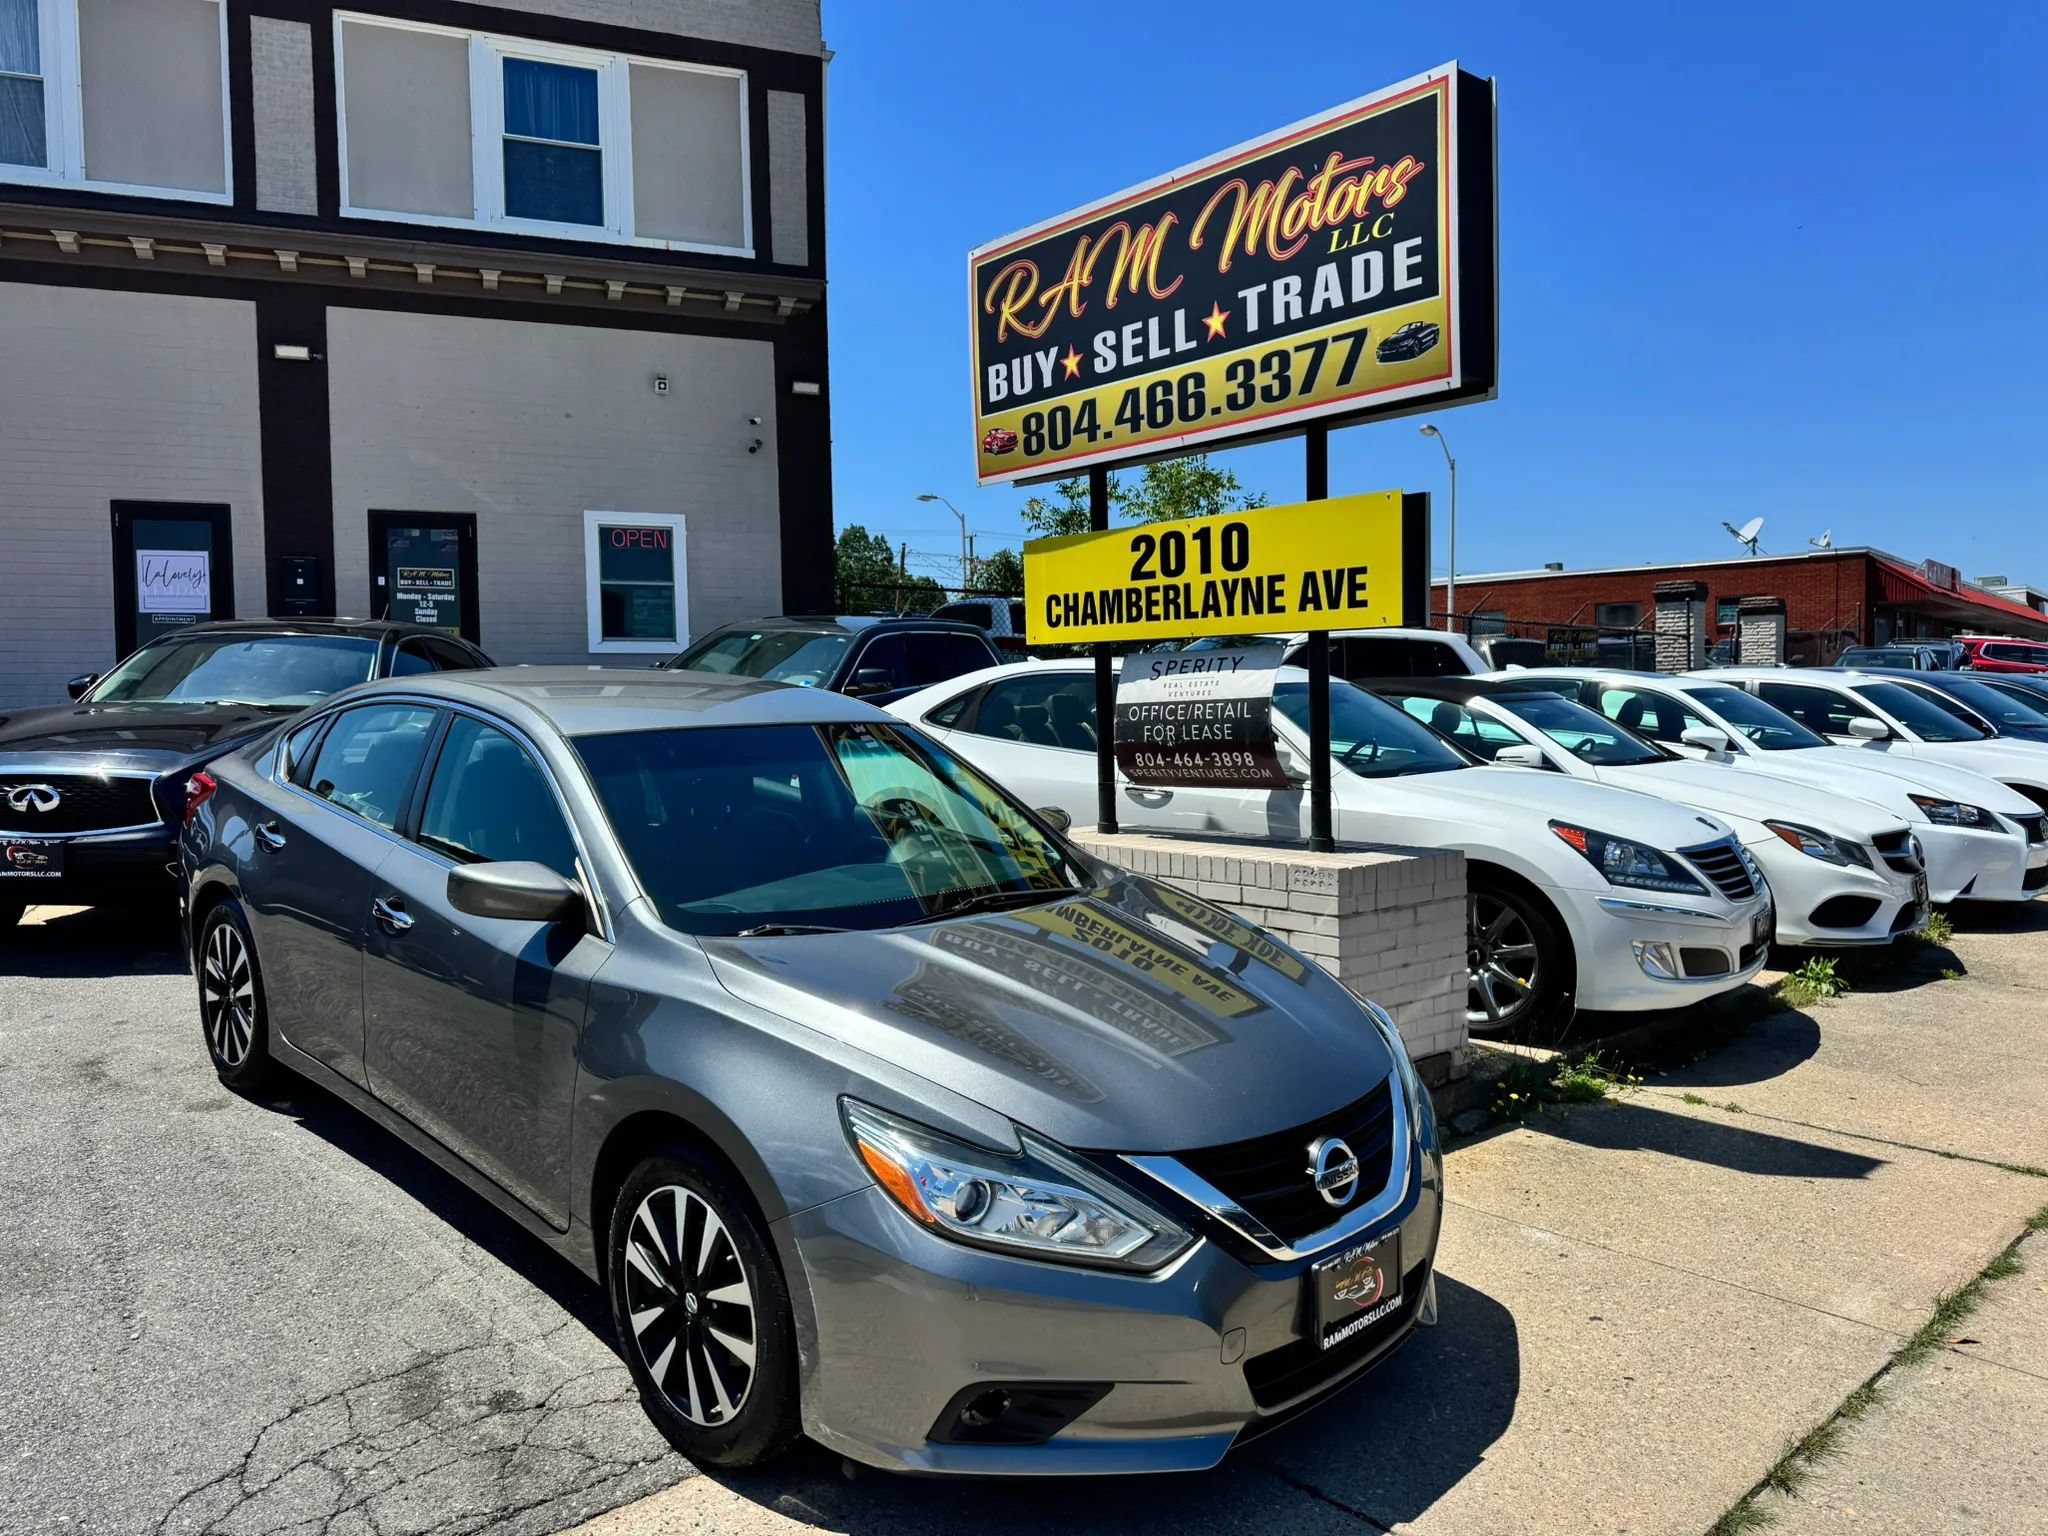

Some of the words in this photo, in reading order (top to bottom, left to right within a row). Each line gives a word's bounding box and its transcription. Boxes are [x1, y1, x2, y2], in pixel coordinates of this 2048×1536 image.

[1189, 151, 1425, 274] Motors
[1327, 211, 1396, 254] LLC
[987, 358, 1064, 403] BUY
[1092, 307, 1198, 375] SELL
[1237, 236, 1423, 332] TRADE
[1021, 327, 1370, 457] 804.466.3377
[612, 528, 667, 549] OPEN
[1130, 521, 1250, 582] 2010
[427, 593, 455, 601] Saturday
[1045, 573, 1287, 629] CHAMBERLAYNE
[1298, 565, 1369, 612] AVE
[414, 608, 438, 616] Sunday
[1150, 655, 1245, 681] SPERITY
[1163, 681, 1184, 689] REAL
[1189, 679, 1220, 688] ESTATE
[1168, 690, 1213, 698] VENTURES
[1128, 702, 1252, 721] OFFICE/RETAIL
[1144, 725, 1176, 741] FOR
[1182, 724, 1233, 740] LEASE
[1135, 752, 1255, 767] 804-464-3898
[1129, 768, 1273, 778] SPERITYVENTURES.COM
[1320, 1162, 1358, 1189] NISSAN
